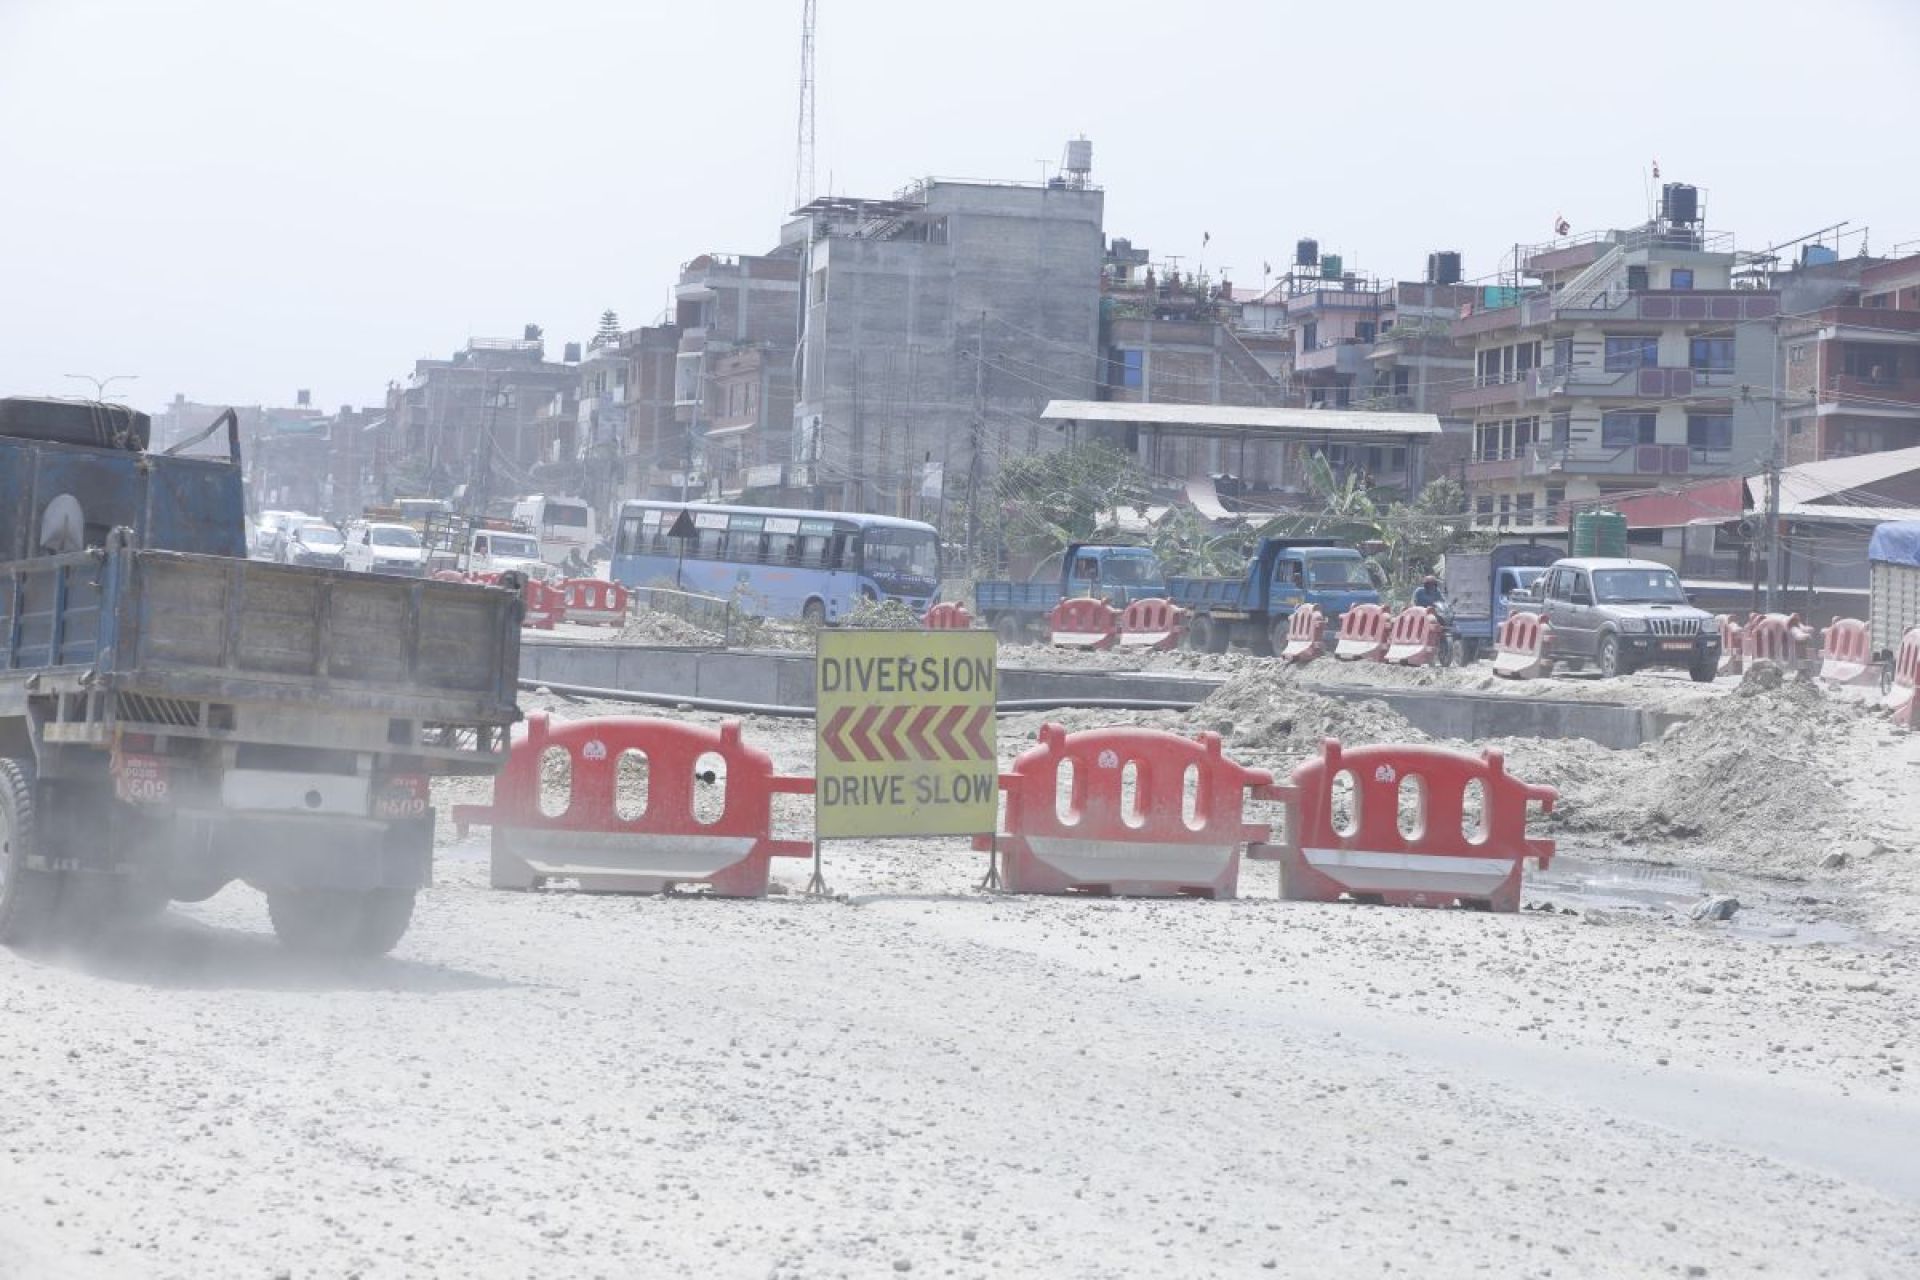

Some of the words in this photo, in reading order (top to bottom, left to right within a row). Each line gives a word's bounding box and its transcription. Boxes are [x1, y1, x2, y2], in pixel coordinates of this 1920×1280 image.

[821, 657, 993, 692] DIVERSION
[823, 775, 905, 806] DRIVE
[915, 773, 993, 804] SLOW
